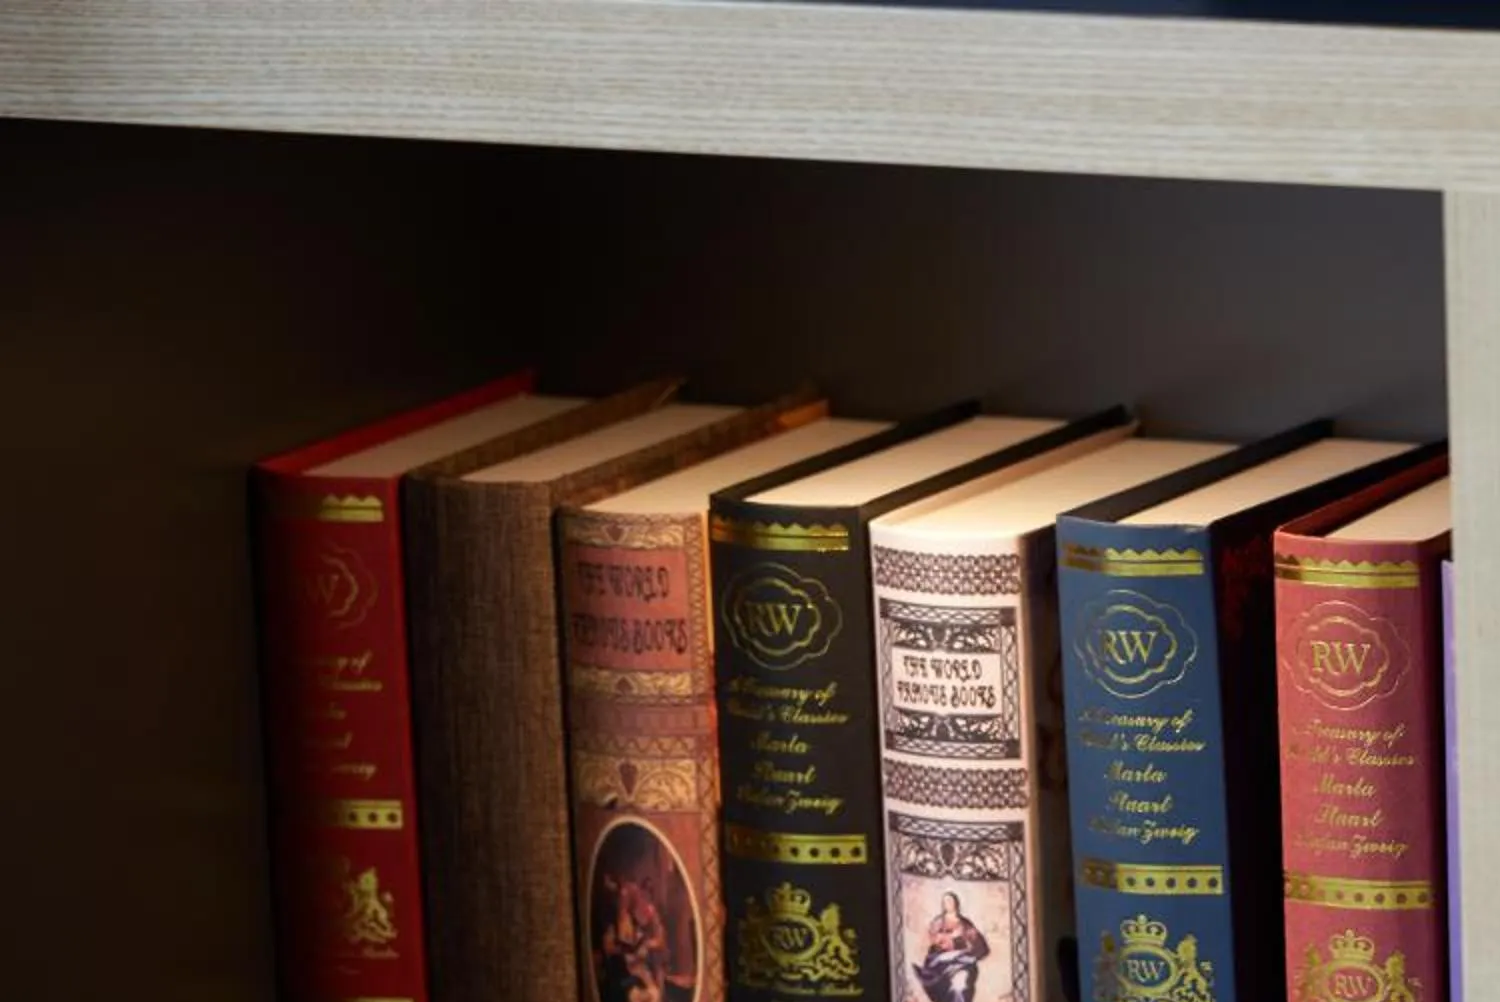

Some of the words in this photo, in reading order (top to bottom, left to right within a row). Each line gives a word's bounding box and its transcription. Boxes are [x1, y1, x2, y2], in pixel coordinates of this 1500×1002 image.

[1098, 630, 1158, 665] RW
[1310, 640, 1371, 676] RW
[930, 658, 982, 682] WORLD
[951, 685, 997, 709] BOOKS
[1170, 707, 1193, 733] of
[1383, 722, 1406, 748] of
[1126, 959, 1165, 983] RW
[1335, 973, 1373, 998] RW
